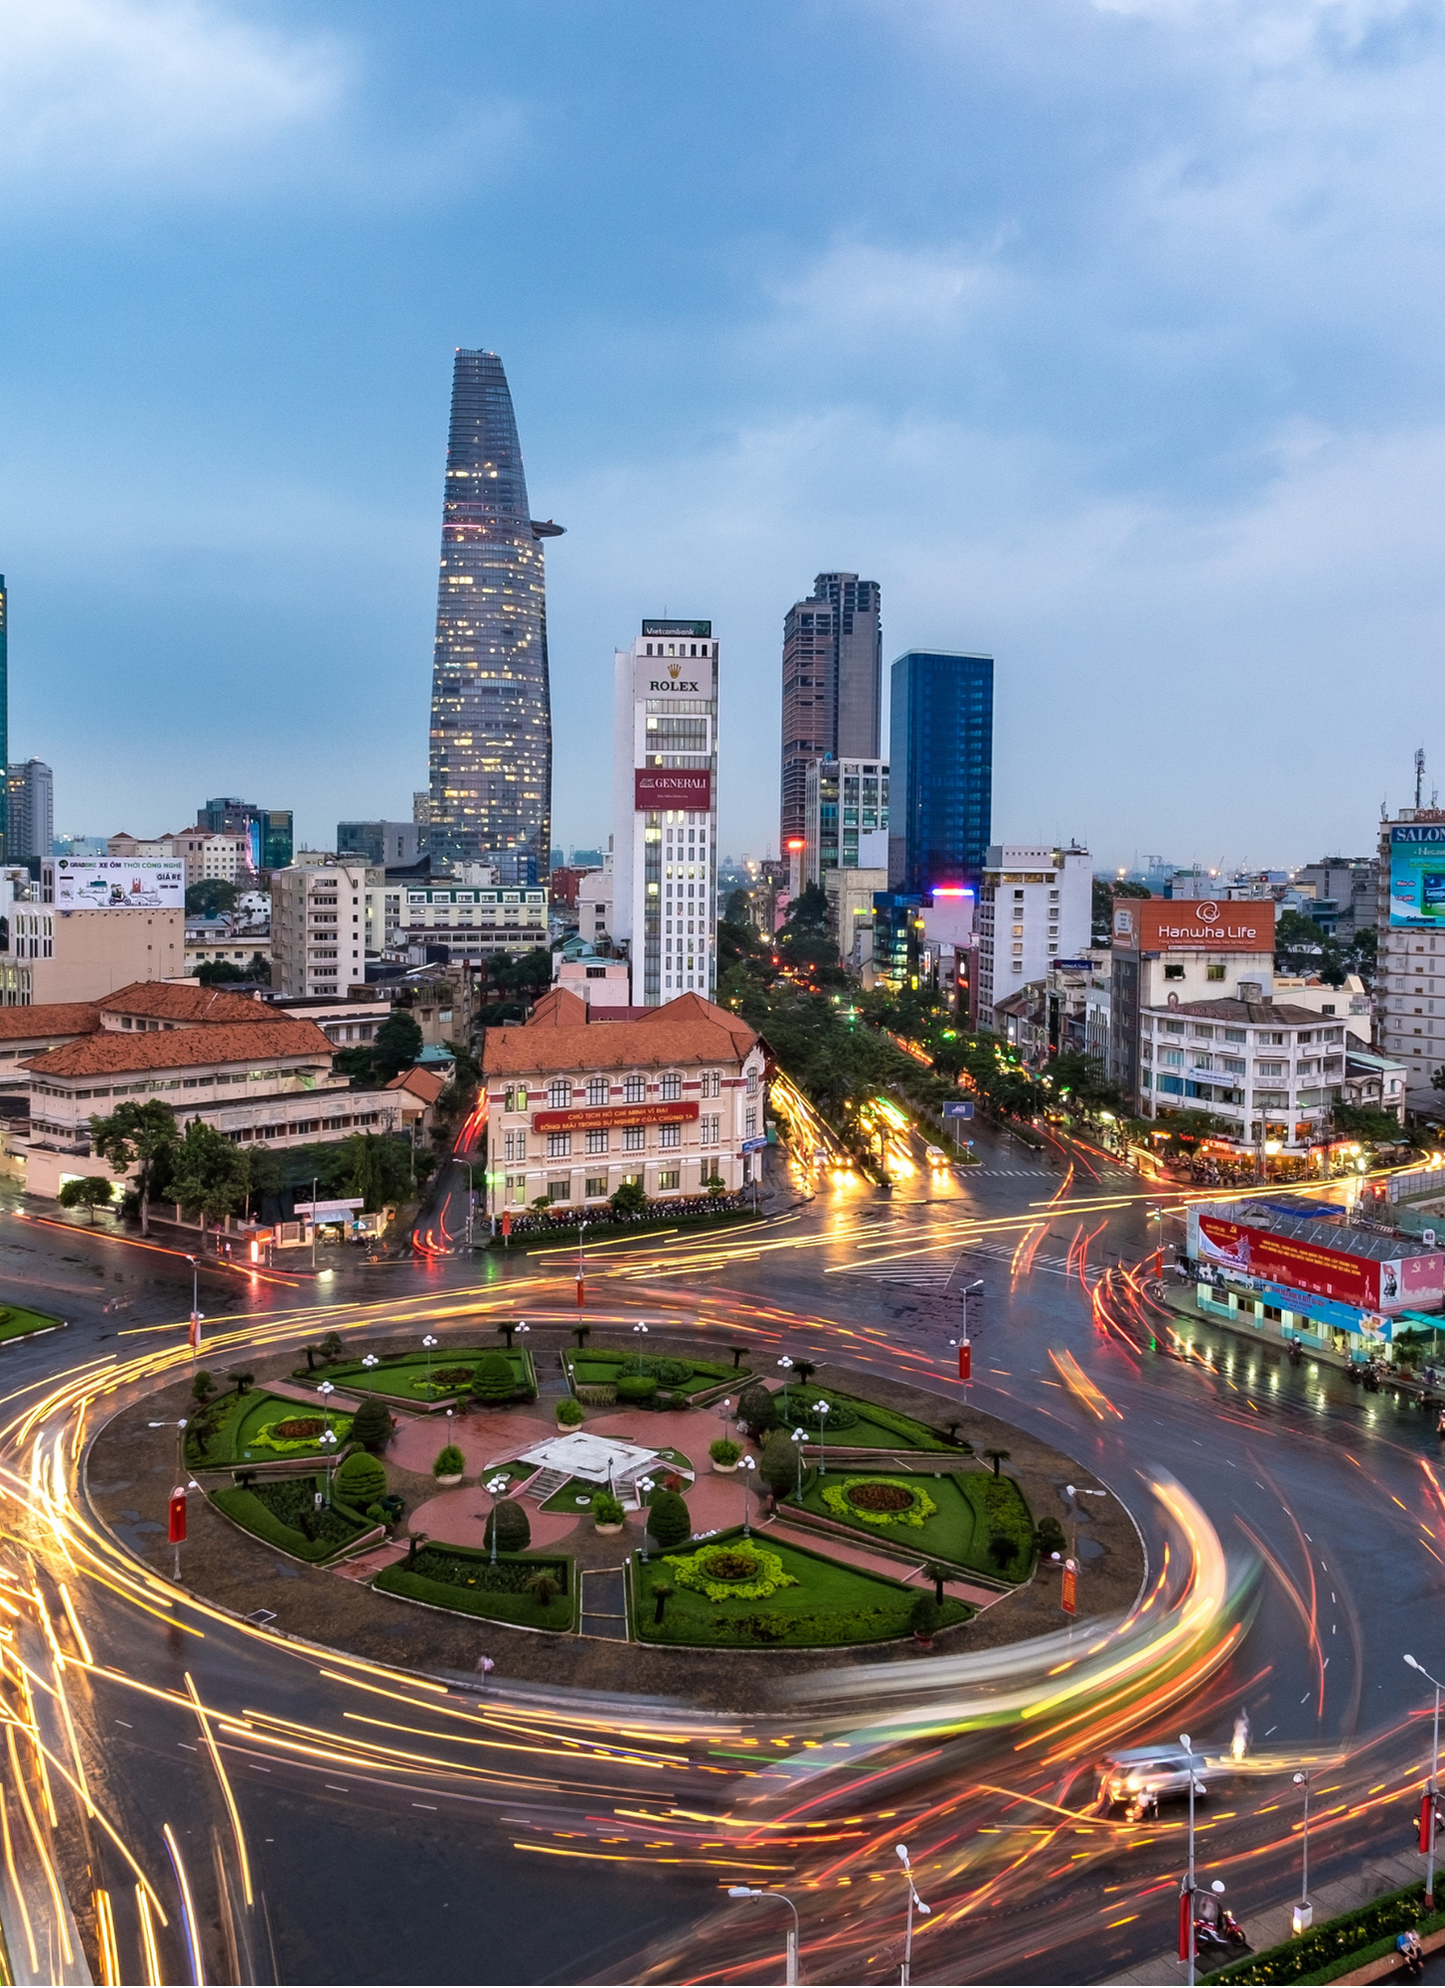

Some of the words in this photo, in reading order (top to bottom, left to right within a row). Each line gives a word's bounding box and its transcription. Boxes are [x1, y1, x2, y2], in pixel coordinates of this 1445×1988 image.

[646, 627, 695, 635] Vietcombank
[650, 681, 699, 691] ROLEX
[655, 778, 706, 789] GENERALI
[1158, 925, 1224, 938] Hanwha
[1227, 926, 1257, 938] Life
[578, 1120, 601, 1128] TRONG
